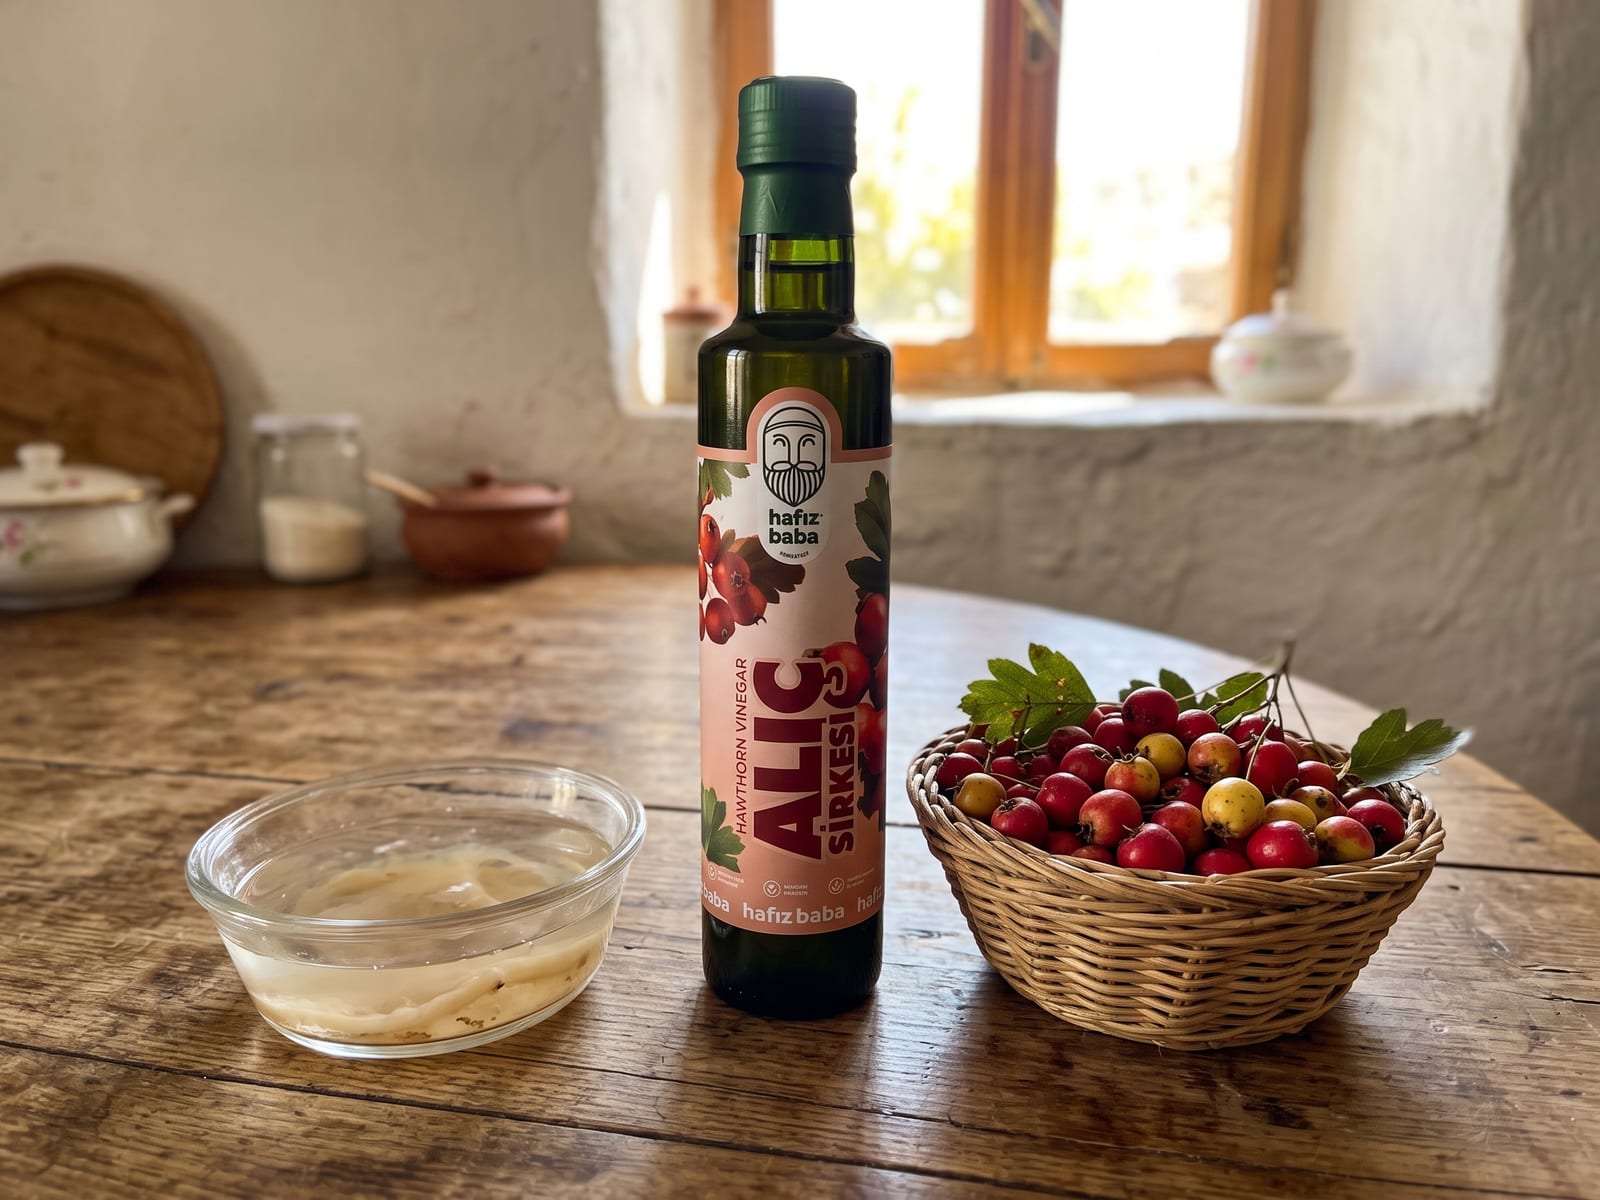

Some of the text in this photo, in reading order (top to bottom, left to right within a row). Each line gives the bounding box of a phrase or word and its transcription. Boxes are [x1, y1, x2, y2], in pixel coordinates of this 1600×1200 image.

[769, 527, 819, 544] baba
[736, 658, 747, 834] HAWTHORN VINEGAR
[753, 661, 844, 860] ALIÇ
[703, 882, 730, 913] baba
[796, 905, 845, 924] baba
